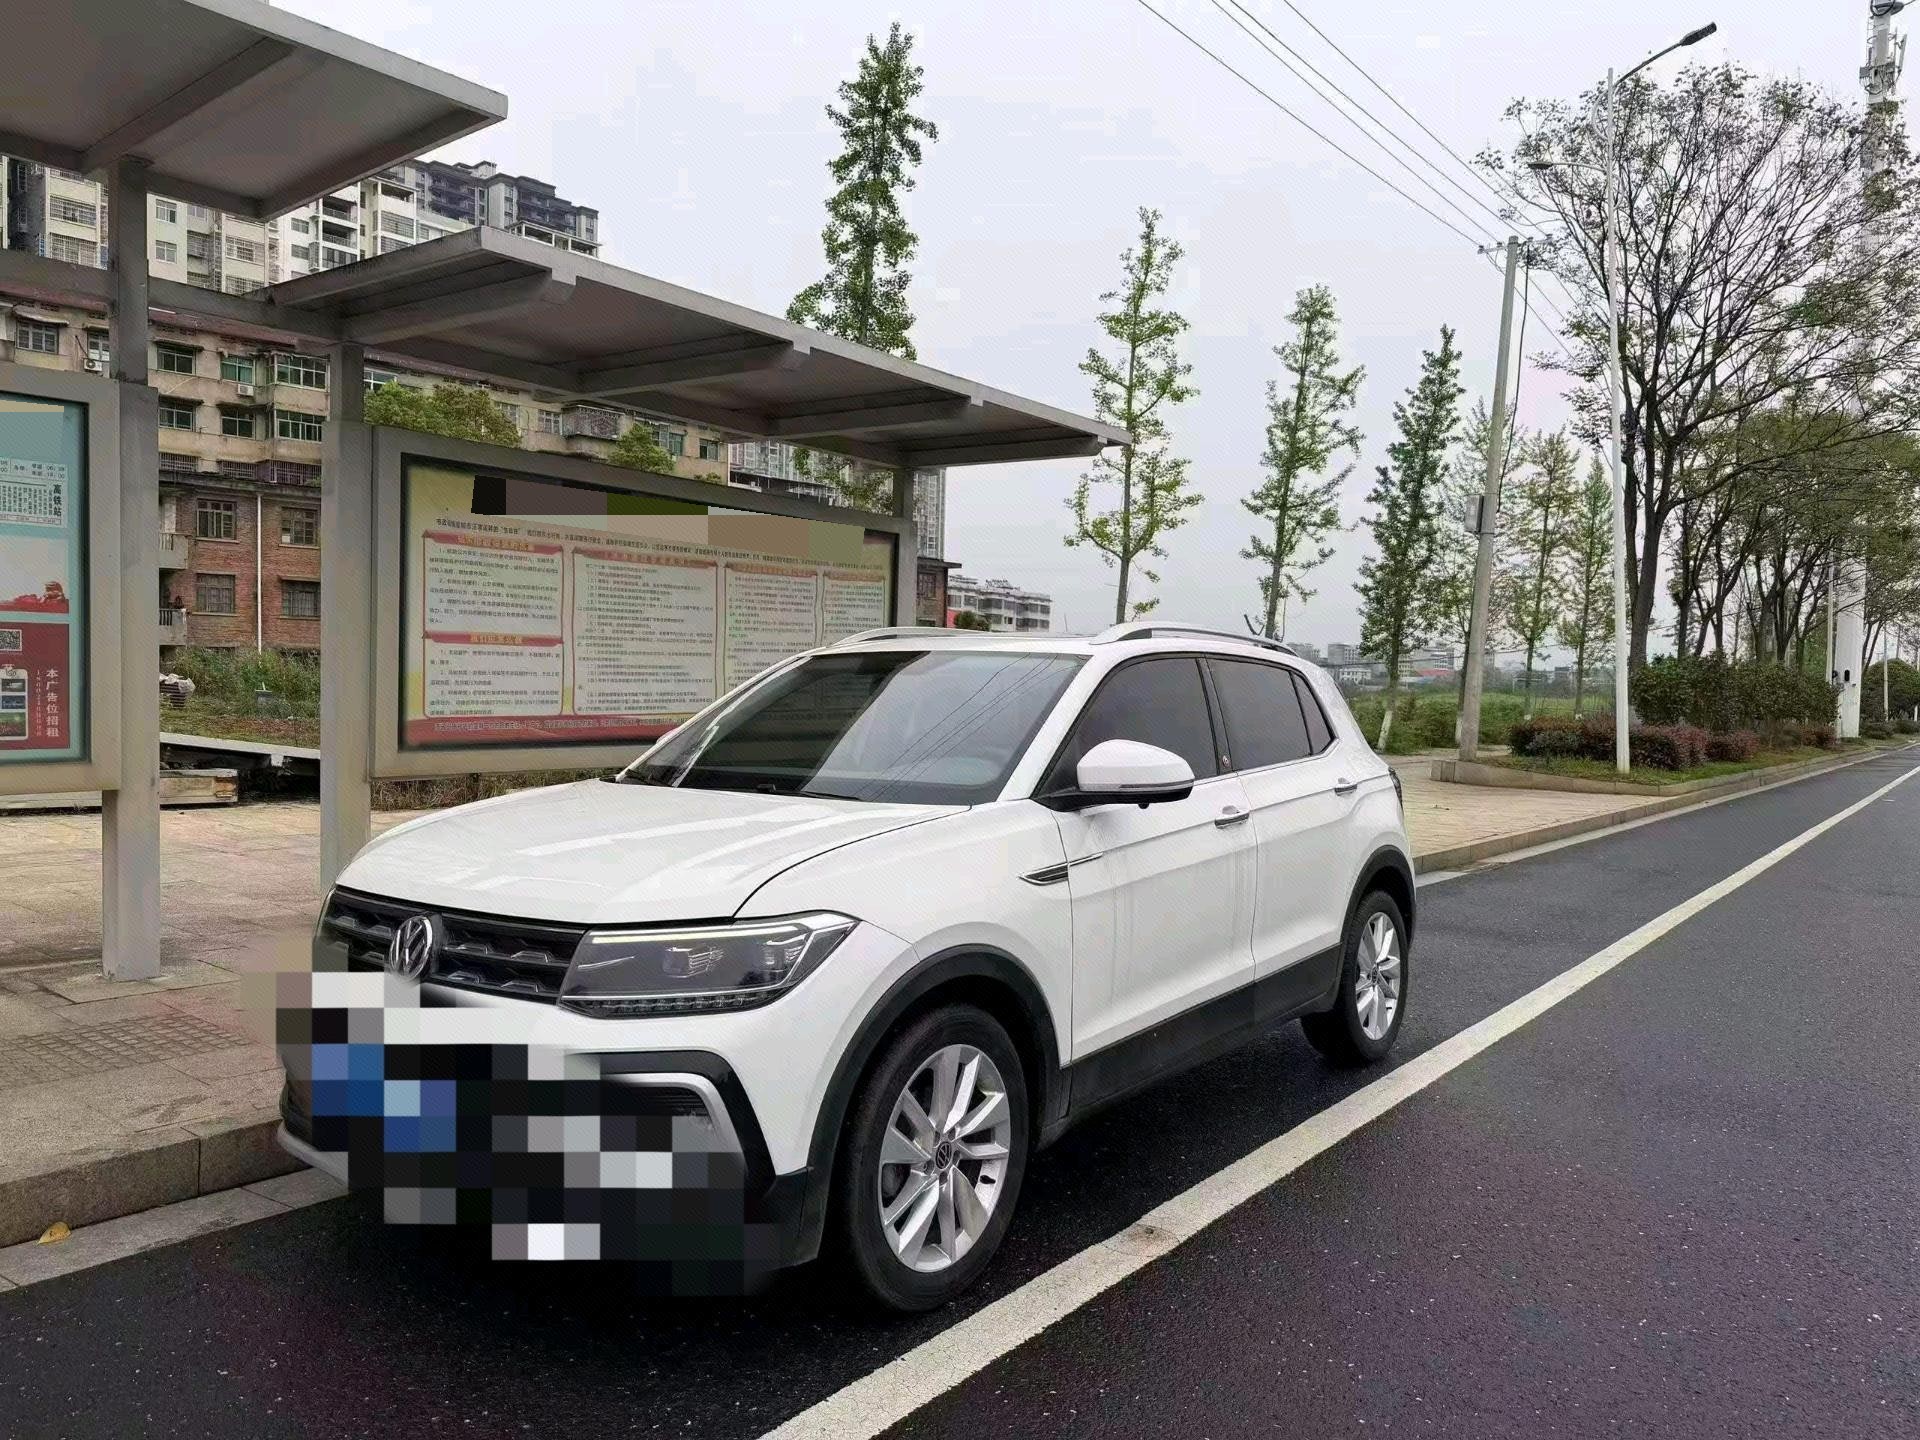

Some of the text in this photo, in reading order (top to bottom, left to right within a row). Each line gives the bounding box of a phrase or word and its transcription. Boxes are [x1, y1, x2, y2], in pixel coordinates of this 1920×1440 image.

[53, 483, 63, 518] 高铁站
[46, 668, 59, 737] 本广告位招租
